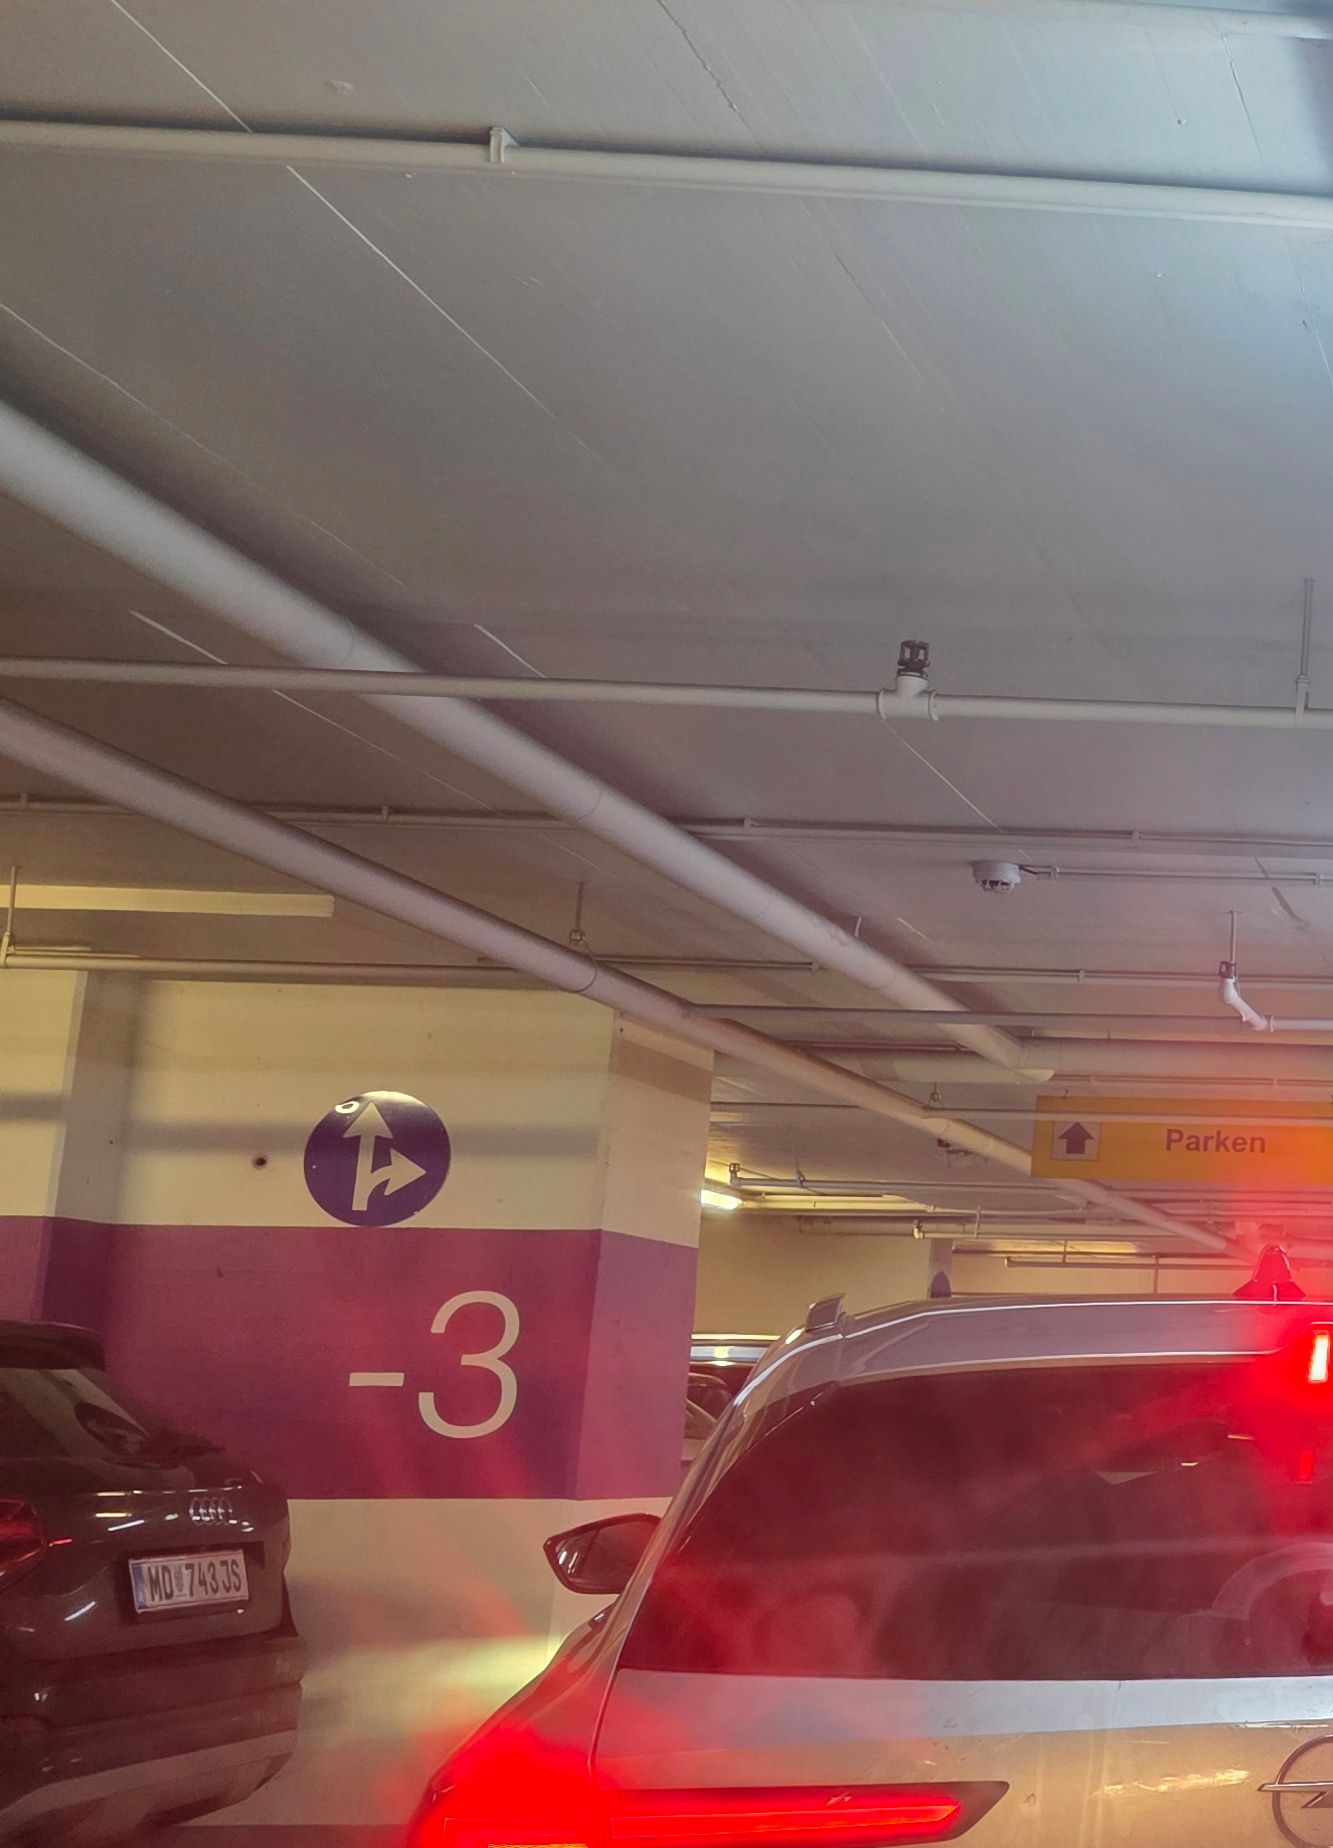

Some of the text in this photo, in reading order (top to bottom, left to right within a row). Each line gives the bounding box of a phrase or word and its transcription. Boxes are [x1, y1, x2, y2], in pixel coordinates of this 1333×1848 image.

[1165, 1127, 1266, 1154] Parken
[347, 1289, 521, 1440] -3
[147, 1565, 173, 1602] MD
